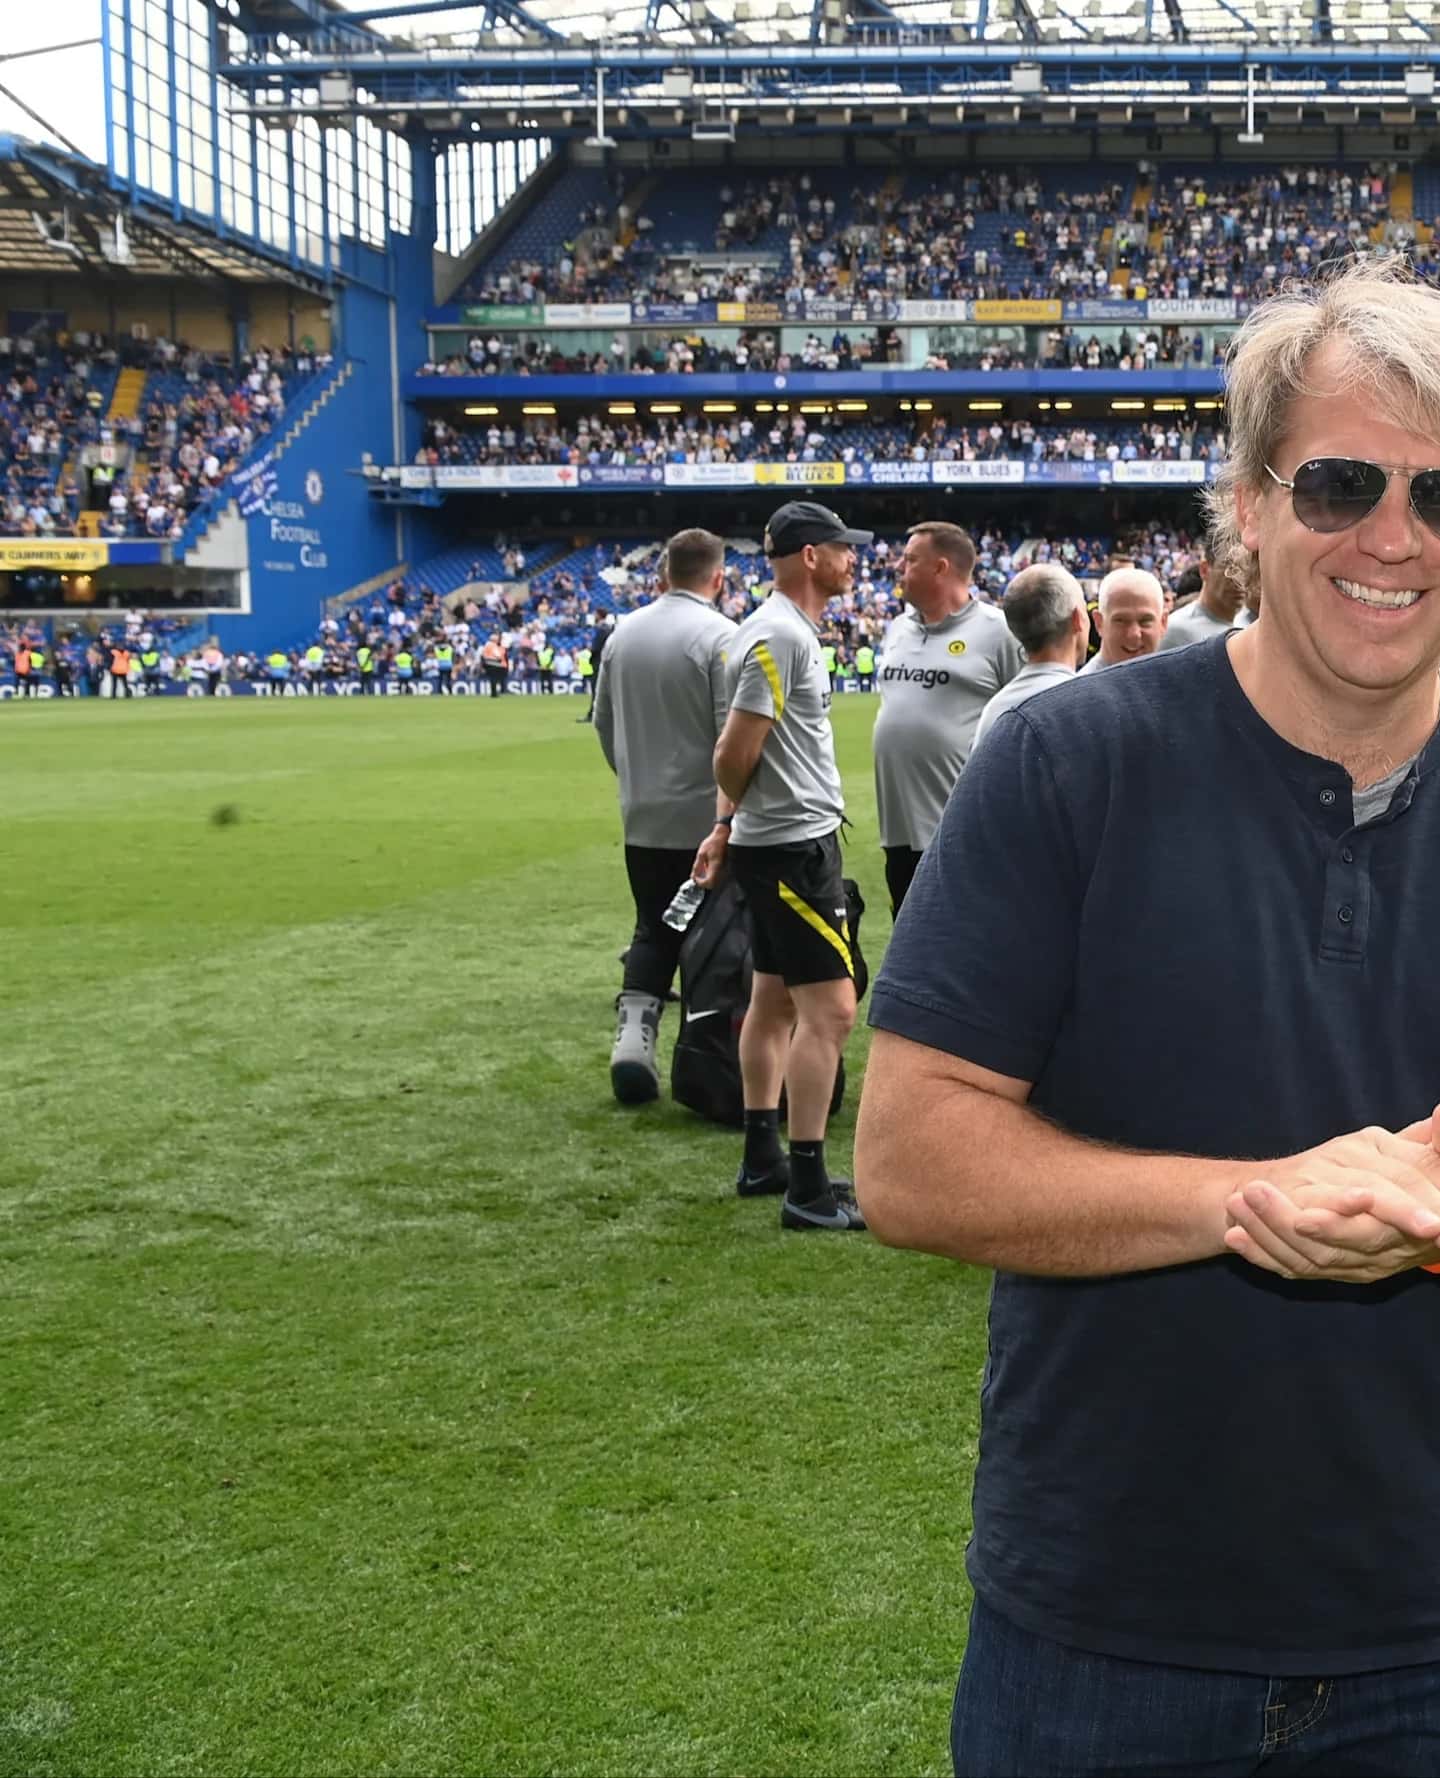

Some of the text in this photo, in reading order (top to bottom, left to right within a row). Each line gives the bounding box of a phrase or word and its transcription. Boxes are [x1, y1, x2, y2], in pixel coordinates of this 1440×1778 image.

[1151, 301, 1195, 312] SOUTH
[870, 462, 930, 473] ADELAIDE
[944, 464, 1011, 477] YORK BLUES
[871, 473, 929, 483] CHELSEA
[271, 518, 322, 544] FOOTBALL
[300, 545, 328, 568] CLUB
[883, 663, 950, 689] trivago
